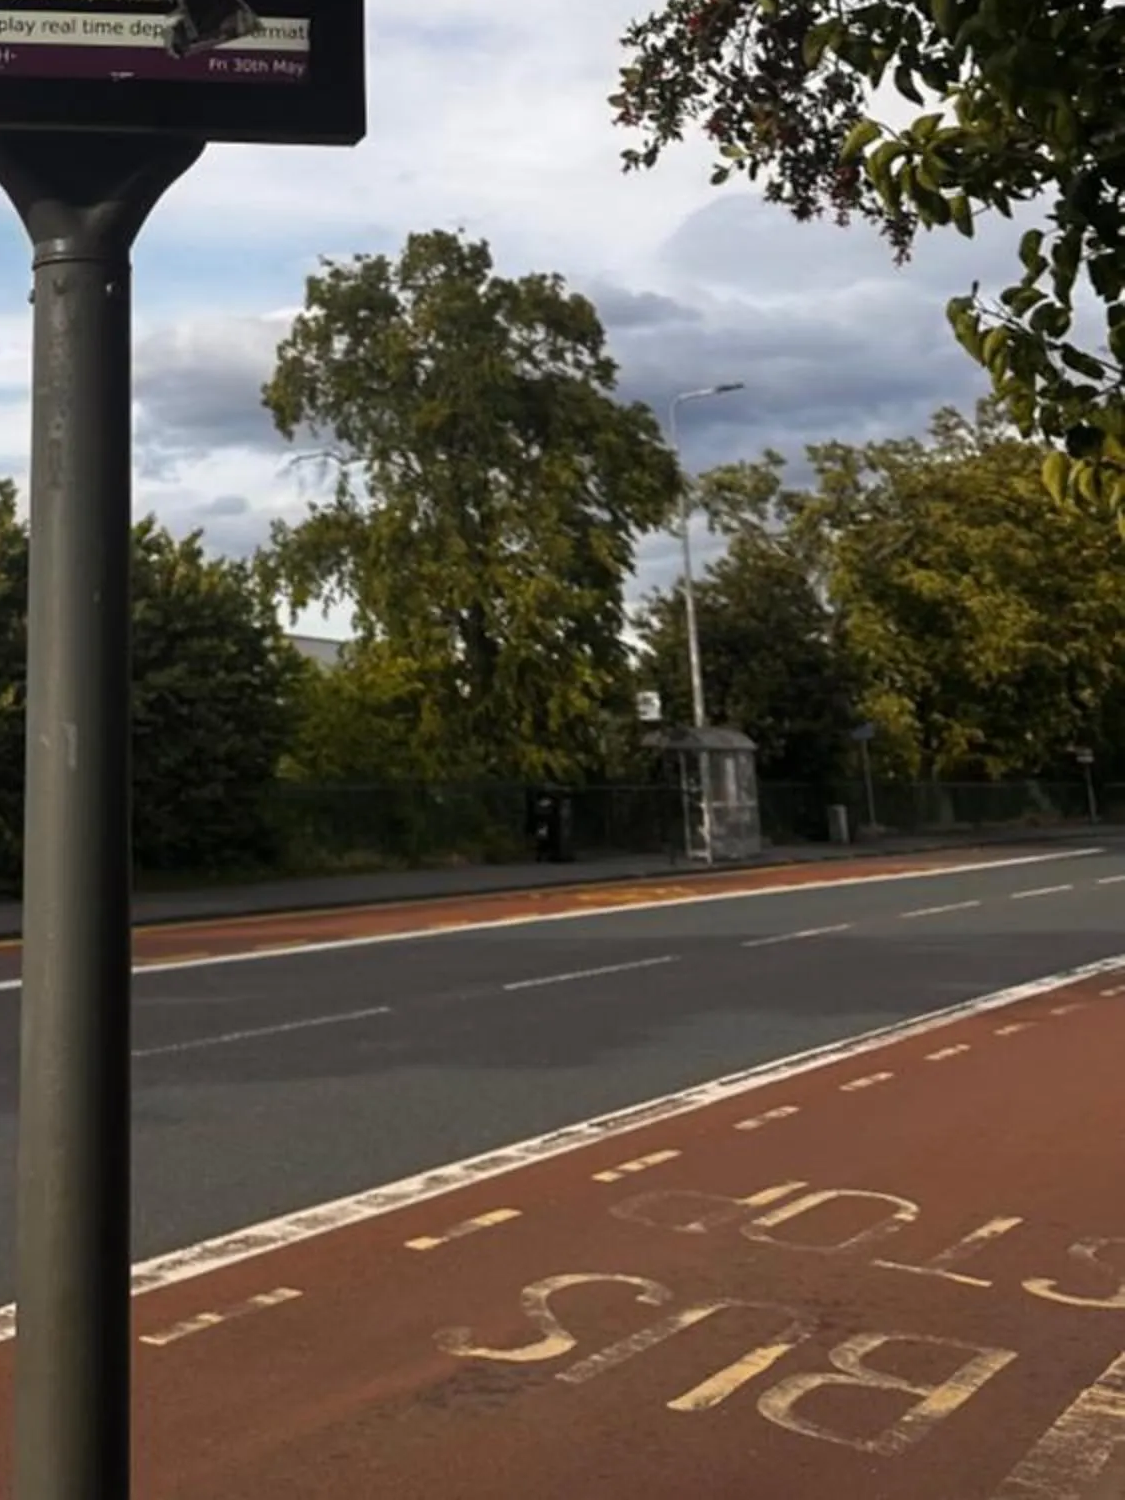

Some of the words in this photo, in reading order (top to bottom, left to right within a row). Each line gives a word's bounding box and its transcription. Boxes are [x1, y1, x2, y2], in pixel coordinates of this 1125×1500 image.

[41, 19, 76, 34] real
[82, 20, 124, 35] time
[208, 58, 227, 71] Fri
[233, 57, 268, 73] 30th
[272, 60, 305, 75] May
[432, 1272, 1019, 1458] BUS
